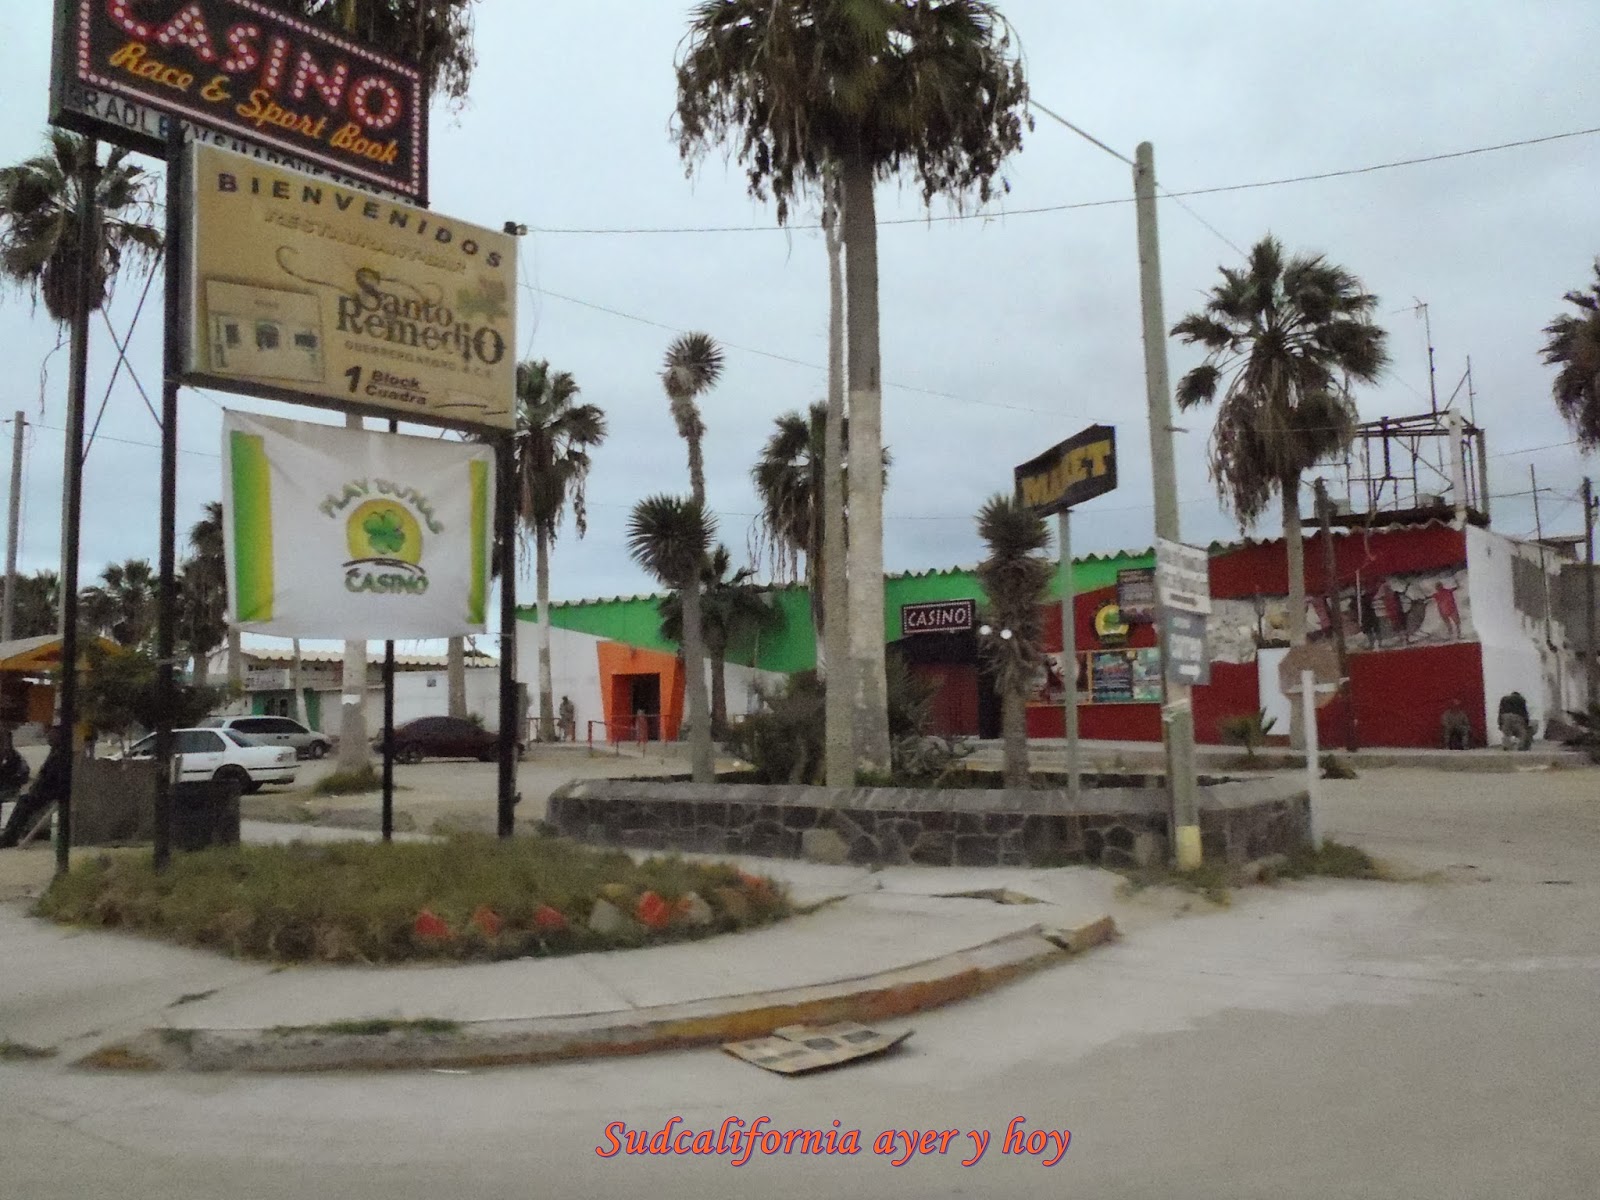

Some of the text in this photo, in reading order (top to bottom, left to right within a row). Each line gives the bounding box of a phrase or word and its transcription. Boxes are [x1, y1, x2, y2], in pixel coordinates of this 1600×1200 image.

[106, 0, 400, 128] CASINO
[109, 42, 194, 91] Race
[201, 75, 232, 101] &
[236, 88, 328, 139] Sport
[330, 122, 398, 166] Book
[218, 172, 502, 267] BIENVENIDOS
[355, 267, 453, 327] Santo
[344, 365, 421, 394] 1 Block
[365, 383, 427, 406] Cuadra
[344, 568, 430, 596] CASINO
[907, 607, 967, 627] CASINO
